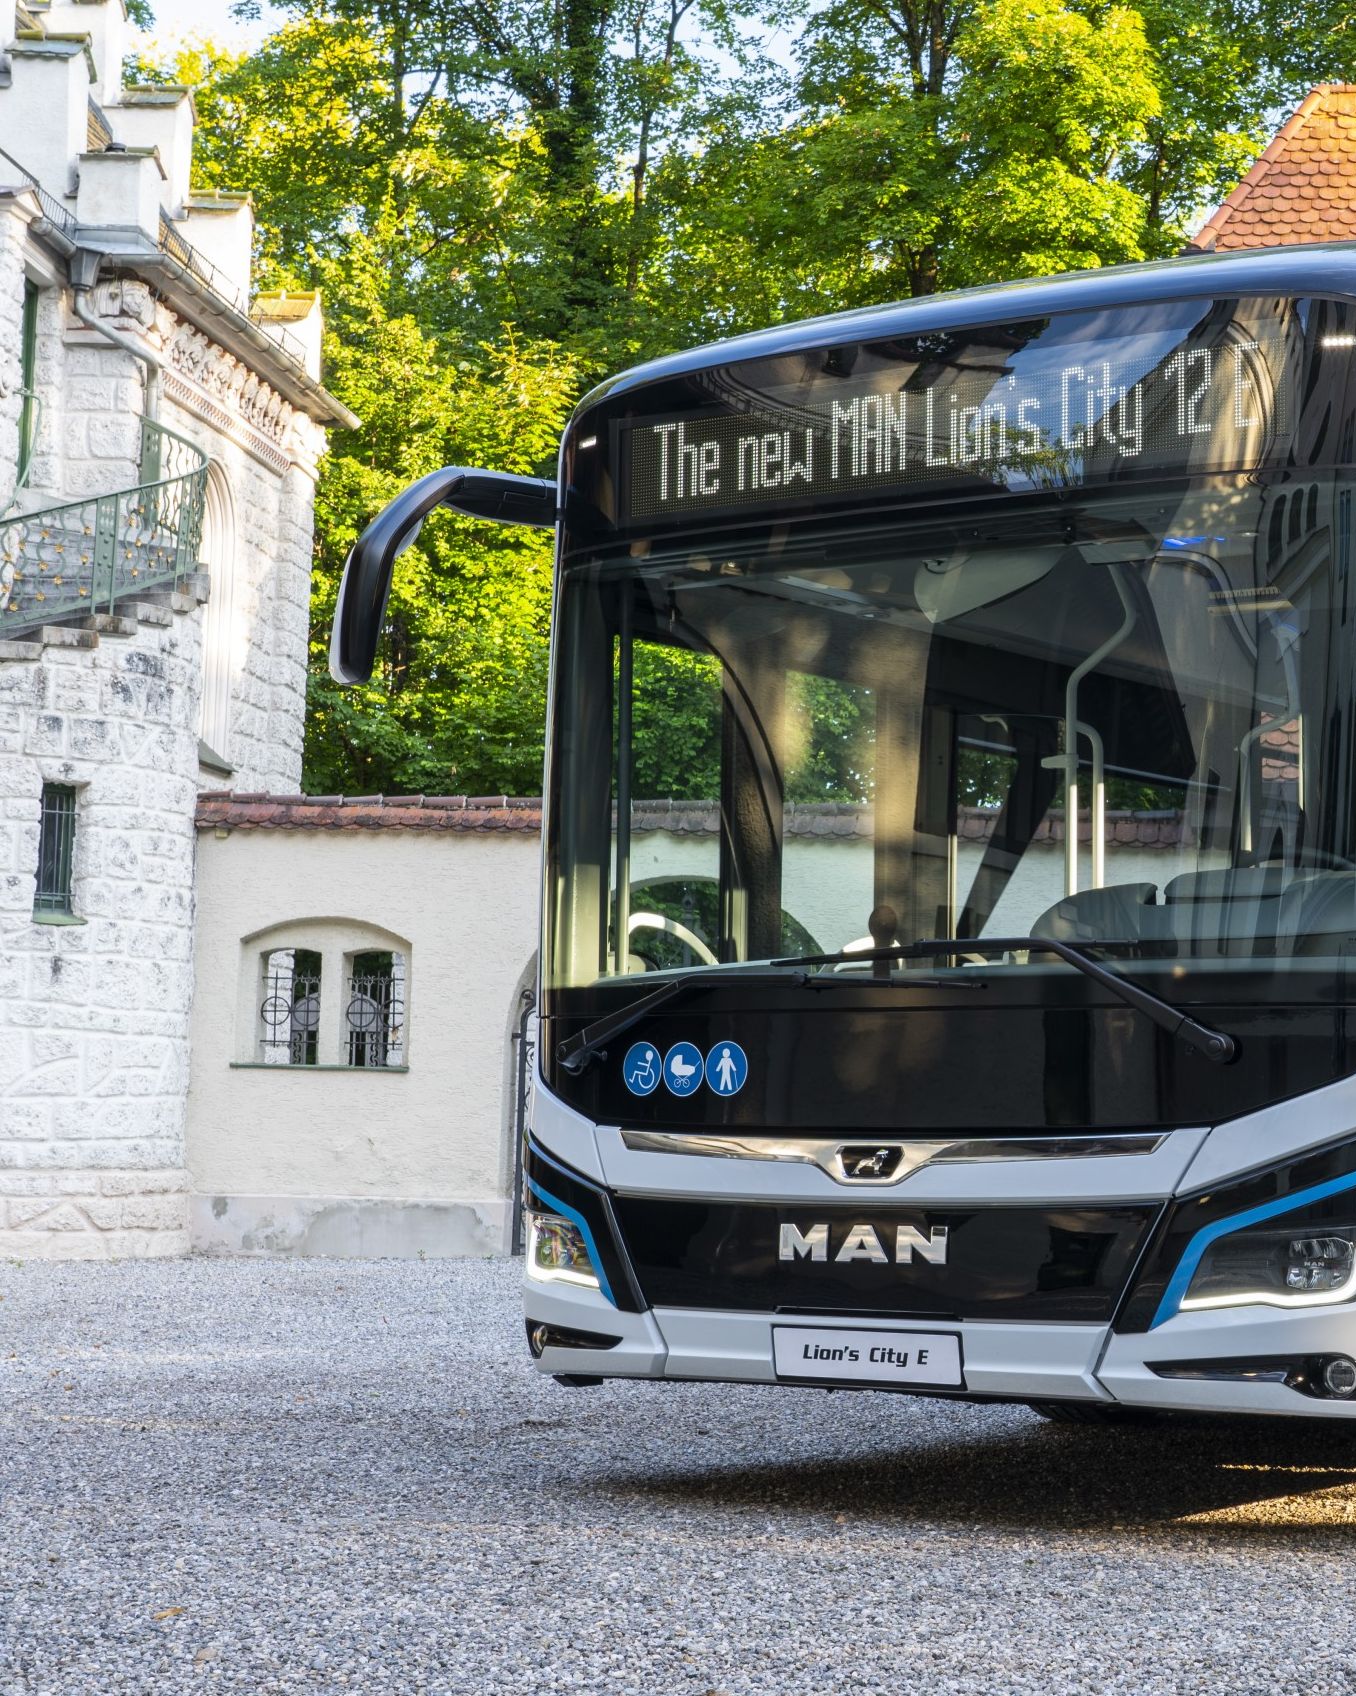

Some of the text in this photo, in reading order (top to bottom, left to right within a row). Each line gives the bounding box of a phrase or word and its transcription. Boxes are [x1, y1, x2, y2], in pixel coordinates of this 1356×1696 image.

[653, 341, 1259, 500] The new MAN Lion's City 12 E
[779, 1223, 949, 1265] MAN
[802, 1344, 929, 1367] Lion's City E
